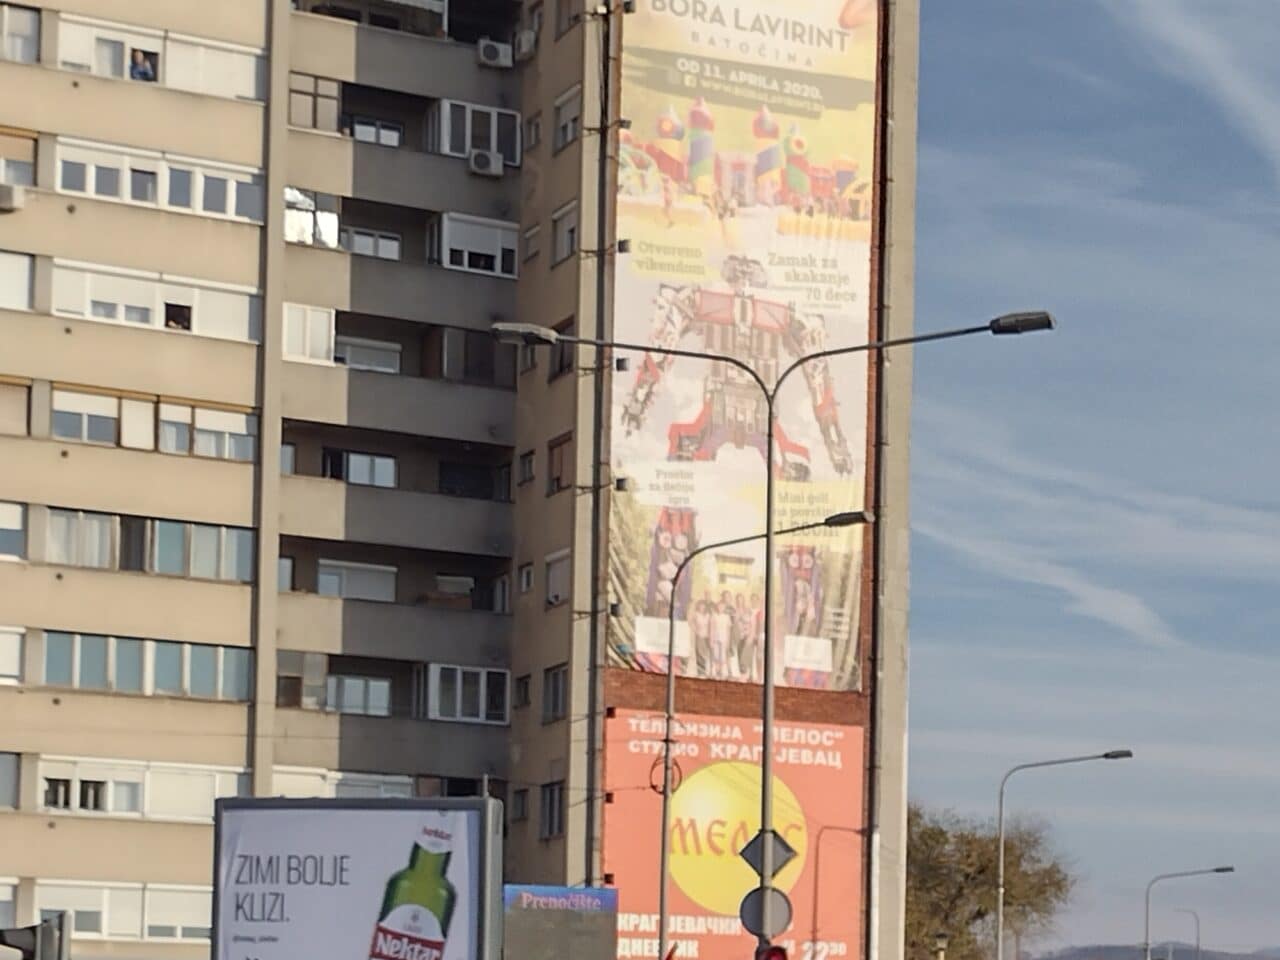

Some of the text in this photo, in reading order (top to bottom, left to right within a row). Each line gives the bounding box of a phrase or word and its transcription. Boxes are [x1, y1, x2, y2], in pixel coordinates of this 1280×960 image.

[734, 8, 850, 51] LAVIRINT
[677, 58, 699, 73] OD
[729, 70, 779, 91] APRILA
[768, 253, 817, 269] Zamak
[784, 268, 850, 285] skakanje
[629, 718, 742, 740] ТЕЛВИЗИЈА
[629, 740, 843, 768] СТУИО КРАГЈЕВАЦ
[235, 854, 350, 886] ZIMI BOLJE
[235, 891, 290, 922] KLIZI.
[617, 913, 741, 935] КРАГЈЕВАЧКИ
